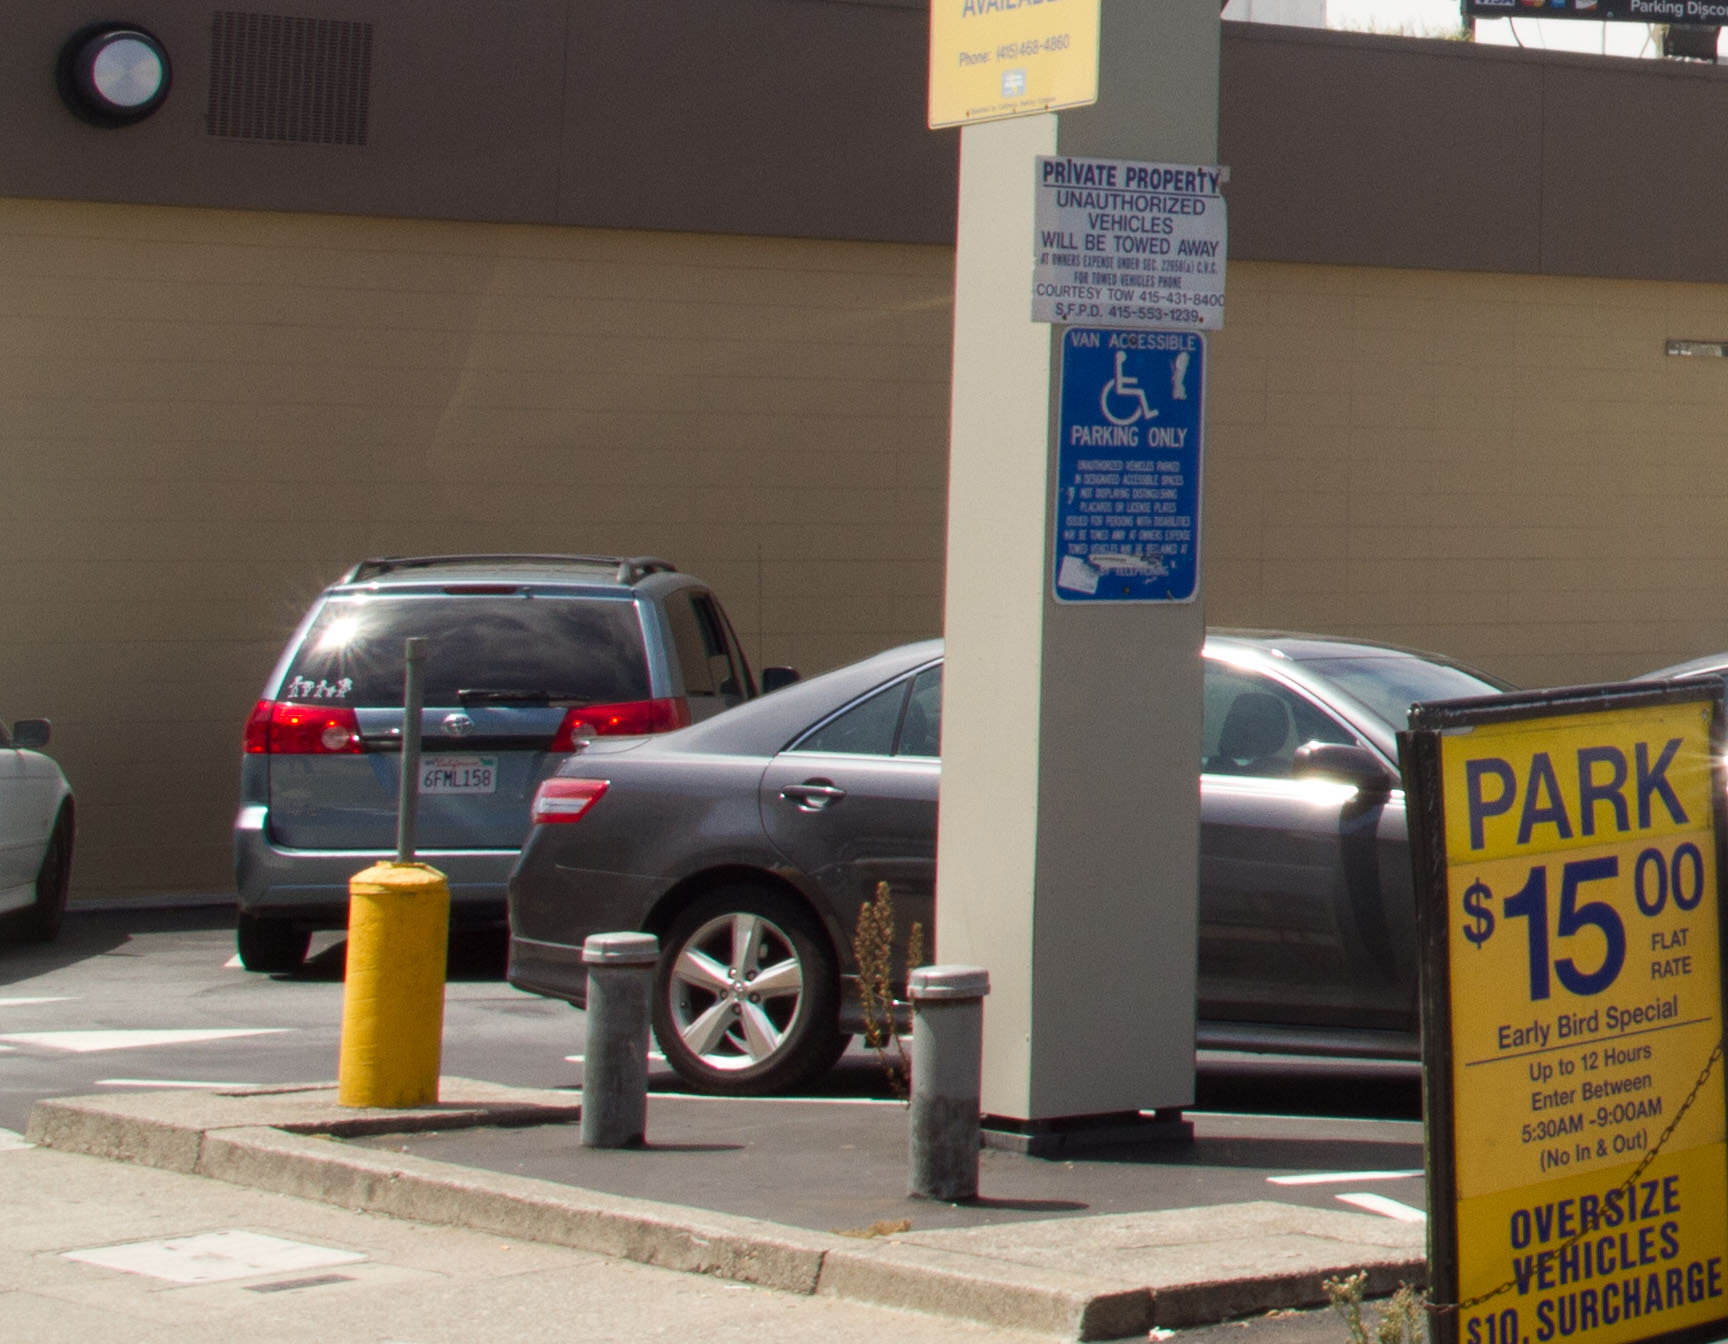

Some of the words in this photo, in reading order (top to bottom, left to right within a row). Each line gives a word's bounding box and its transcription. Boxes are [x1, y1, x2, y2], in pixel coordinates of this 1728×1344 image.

[1630, 0, 1684, 16] Parking
[1043, 160, 1117, 187] PRIVATE
[1125, 166, 1220, 194] PROPERTY
[1057, 190, 1206, 215] UNAUTHORIZED
[1088, 213, 1174, 235] VEHICLES
[1042, 231, 1078, 250] WILL
[1085, 234, 1106, 251] BE
[1114, 235, 1171, 255] TOWED
[1178, 239, 1220, 257] AWAY
[1041, 253, 1050, 265] AT
[1083, 256, 1114, 269] EXPENSE
[1036, 283, 1103, 299] COURTESY
[1107, 288, 1135, 302] TOW
[1074, 272, 1089, 284] FOR
[1092, 273, 1117, 286] TOWED
[1120, 274, 1155, 288] VEHICLES
[1158, 276, 1182, 289] PHONE
[1055, 302, 1103, 318] S.F.P.D.
[1071, 332, 1100, 348] VAN
[1109, 333, 1196, 351] ACCESSIBLE
[1071, 424, 1139, 447] PARKING
[1149, 427, 1188, 448] ONLY
[424, 769, 492, 788] 6FML158
[1465, 738, 1690, 852] PARK
[1651, 929, 1690, 952] FLAT
[1650, 955, 1692, 980] RATE
[1498, 1019, 1551, 1050] Early
[1557, 1010, 1600, 1040] Bird
[1605, 994, 1679, 1033] Special
[1529, 1062, 1553, 1083] Up
[1558, 1058, 1575, 1076] to
[1581, 1052, 1599, 1071] 12
[1604, 1044, 1653, 1068] Hours
[1531, 1090, 1576, 1113] Enter
[1581, 1073, 1653, 1103] Between
[1521, 1113, 1584, 1144] 5:30AM
[1540, 1149, 1571, 1173] (No
[1575, 1143, 1592, 1163] In
[1596, 1138, 1609, 1157] &
[1612, 1128, 1650, 1154] Out)
[1508, 1174, 1682, 1251] OVERSIZE
[1513, 1220, 1680, 1296] VEHICLES
[1536, 1257, 1724, 1342] SURCHARGE
